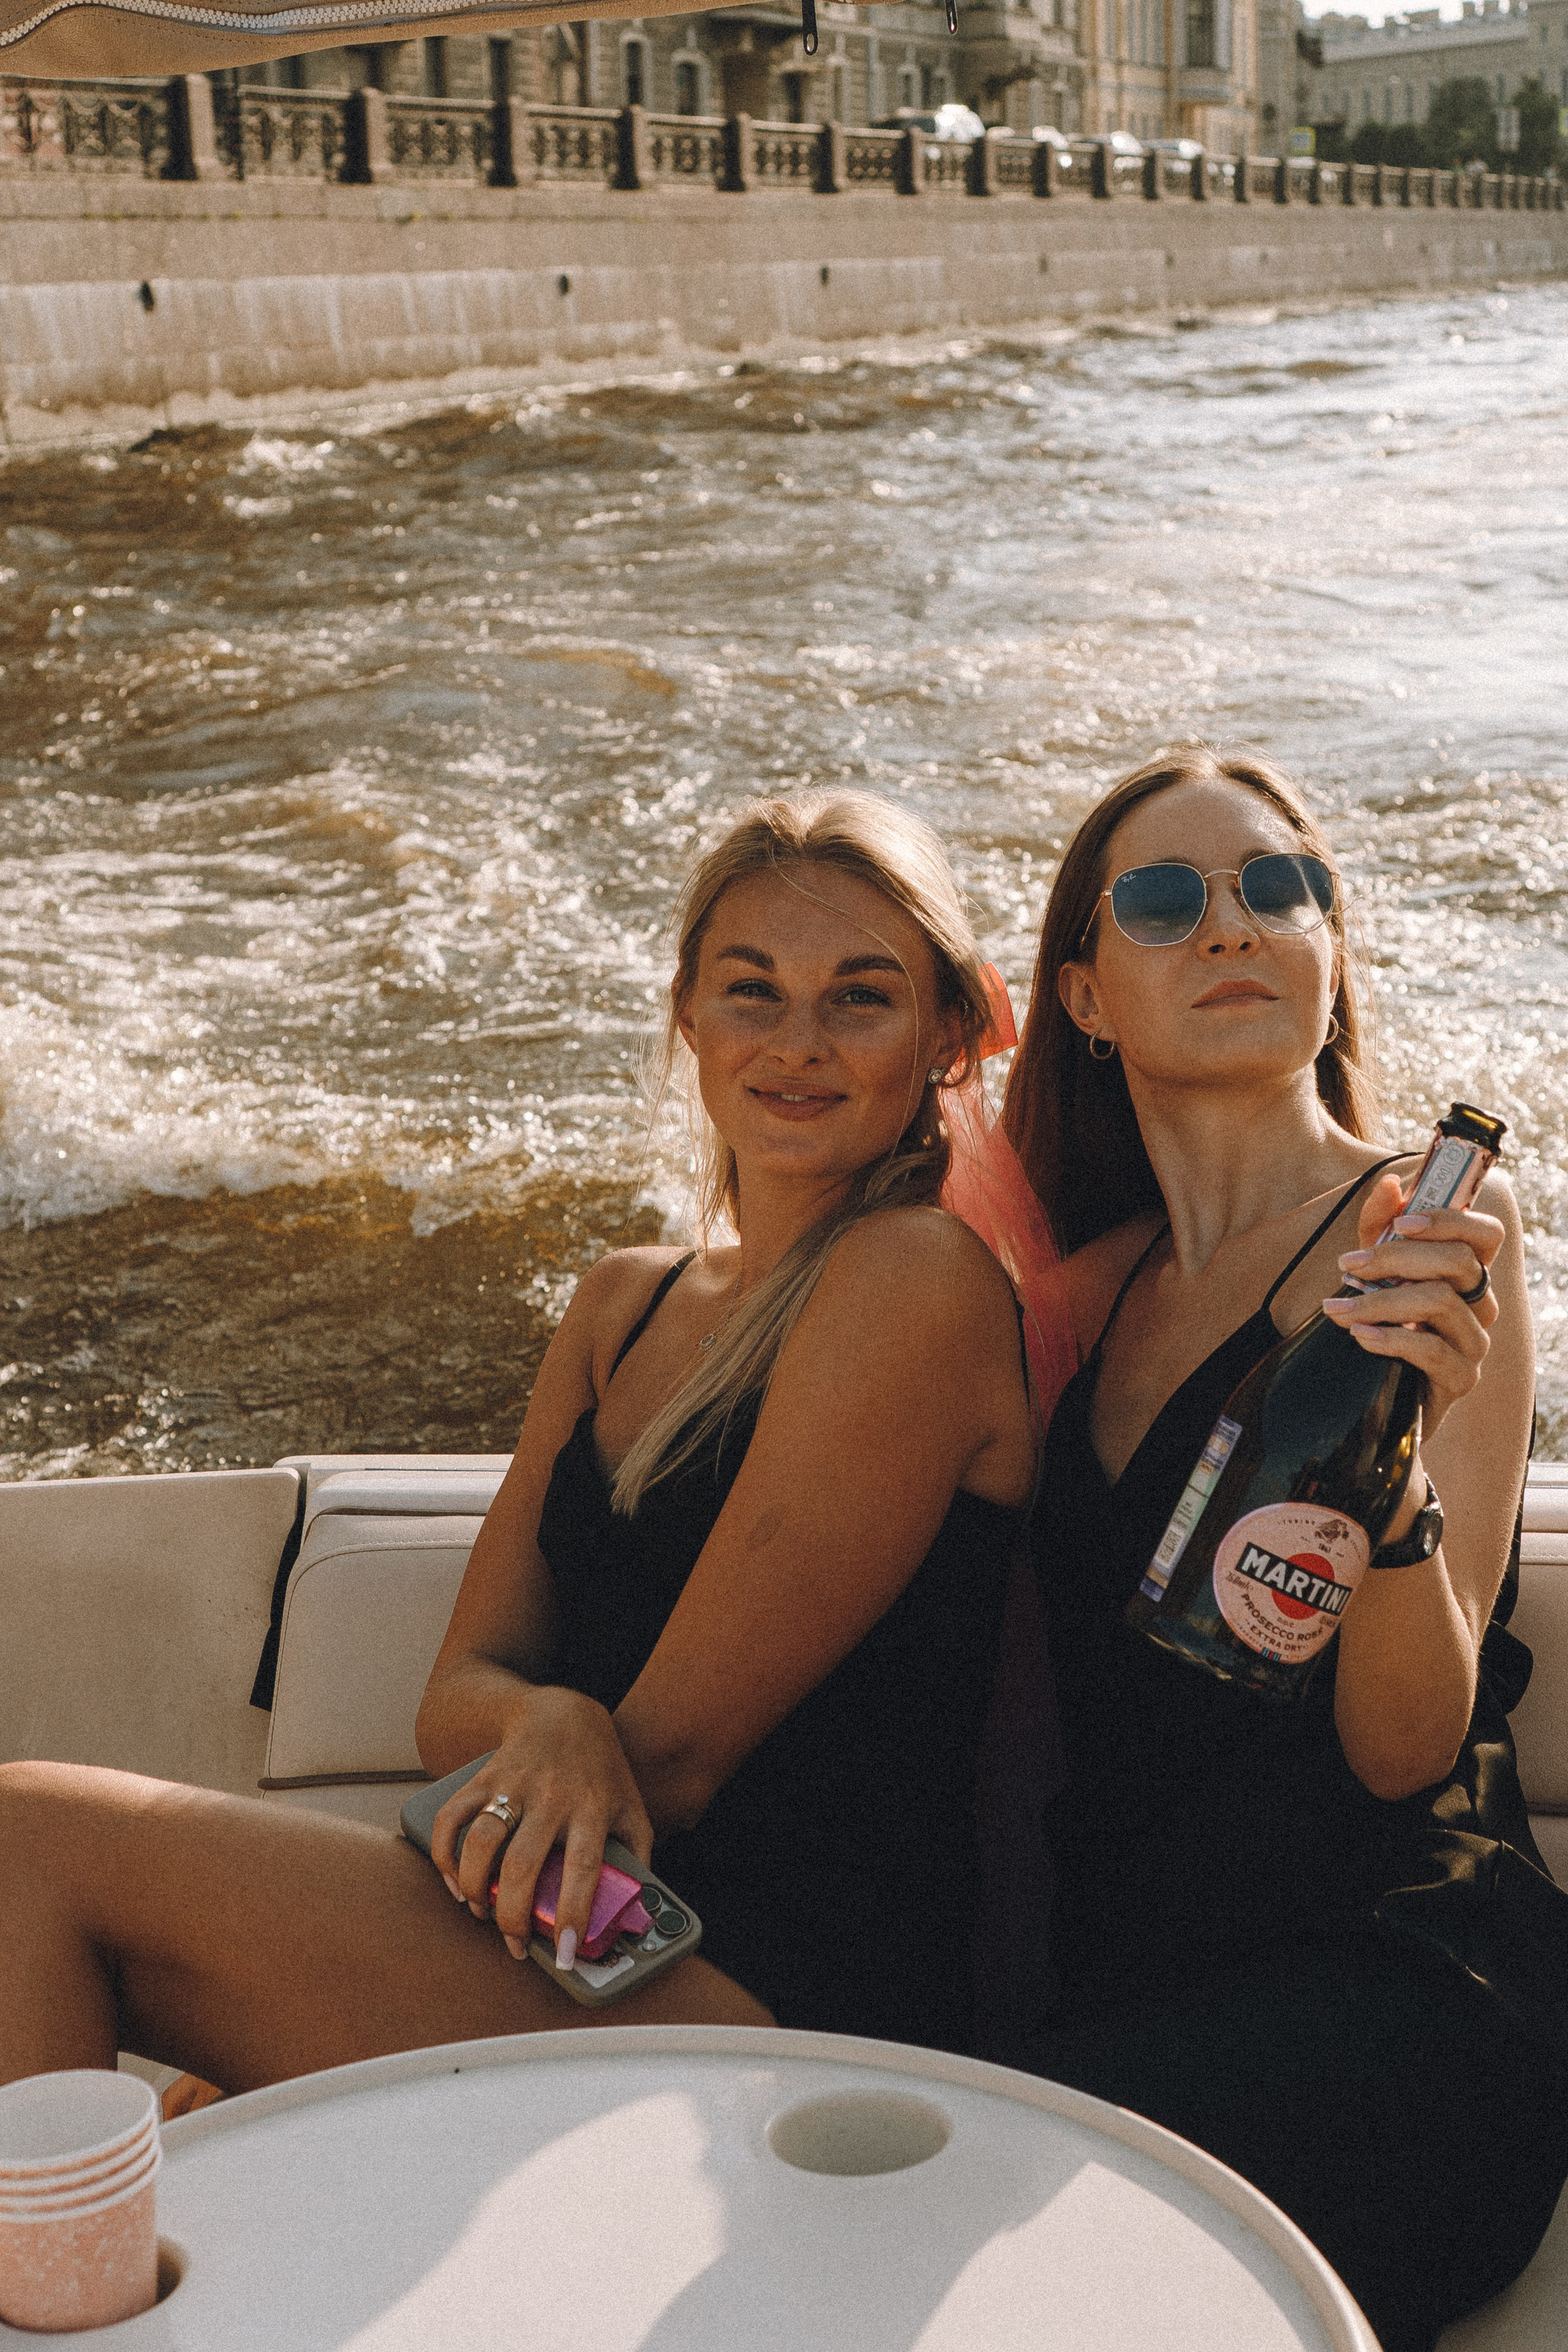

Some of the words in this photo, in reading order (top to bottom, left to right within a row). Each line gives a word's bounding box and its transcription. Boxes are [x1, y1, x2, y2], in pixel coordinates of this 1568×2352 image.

[1241, 1547, 1349, 1613] MARTINI
[1241, 1593, 1294, 1640] PROSECCO
[1250, 1625, 1281, 1648] EXTRA
